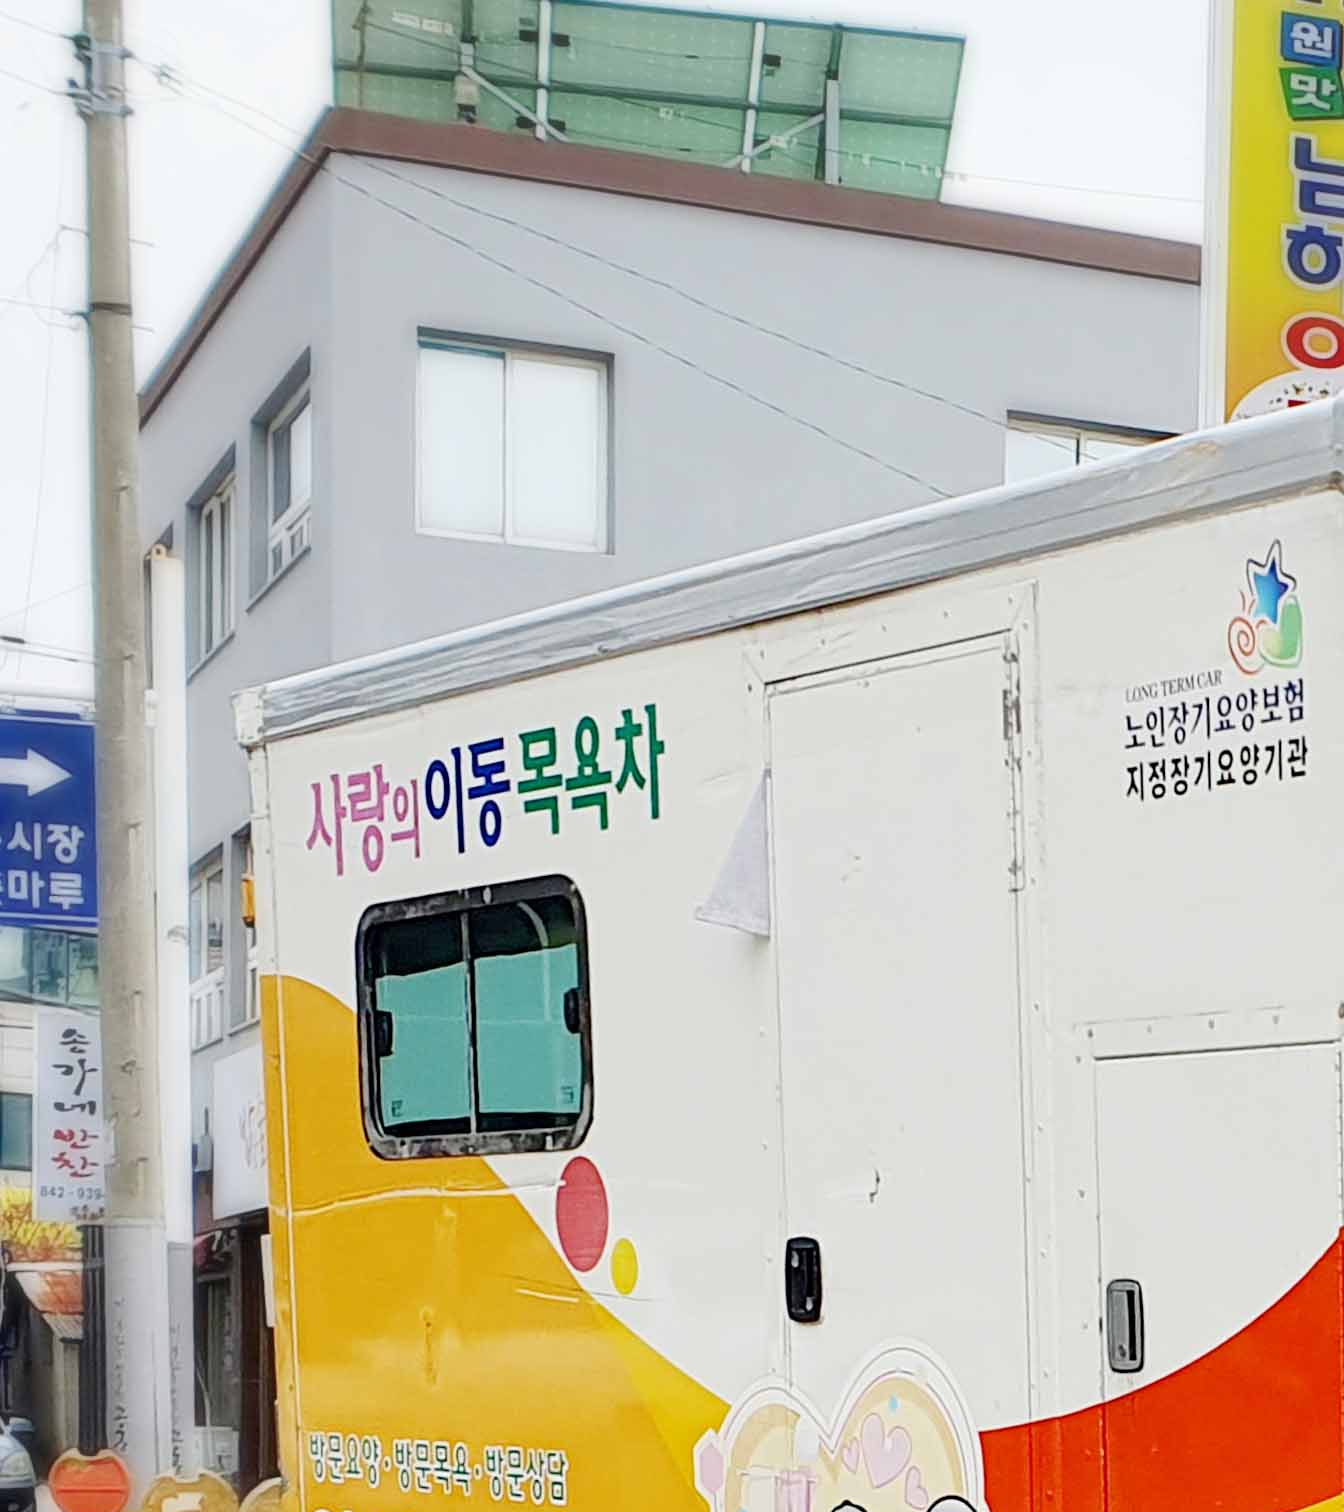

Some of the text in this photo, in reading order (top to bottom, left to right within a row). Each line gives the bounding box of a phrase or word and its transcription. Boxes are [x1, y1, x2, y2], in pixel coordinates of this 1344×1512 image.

[1124, 678, 1304, 750] 노인장기요양보험
[1125, 736, 1308, 802] 지정장기요양기관
[0, 821, 85, 865] 시장
[0, 869, 84, 910] 마루
